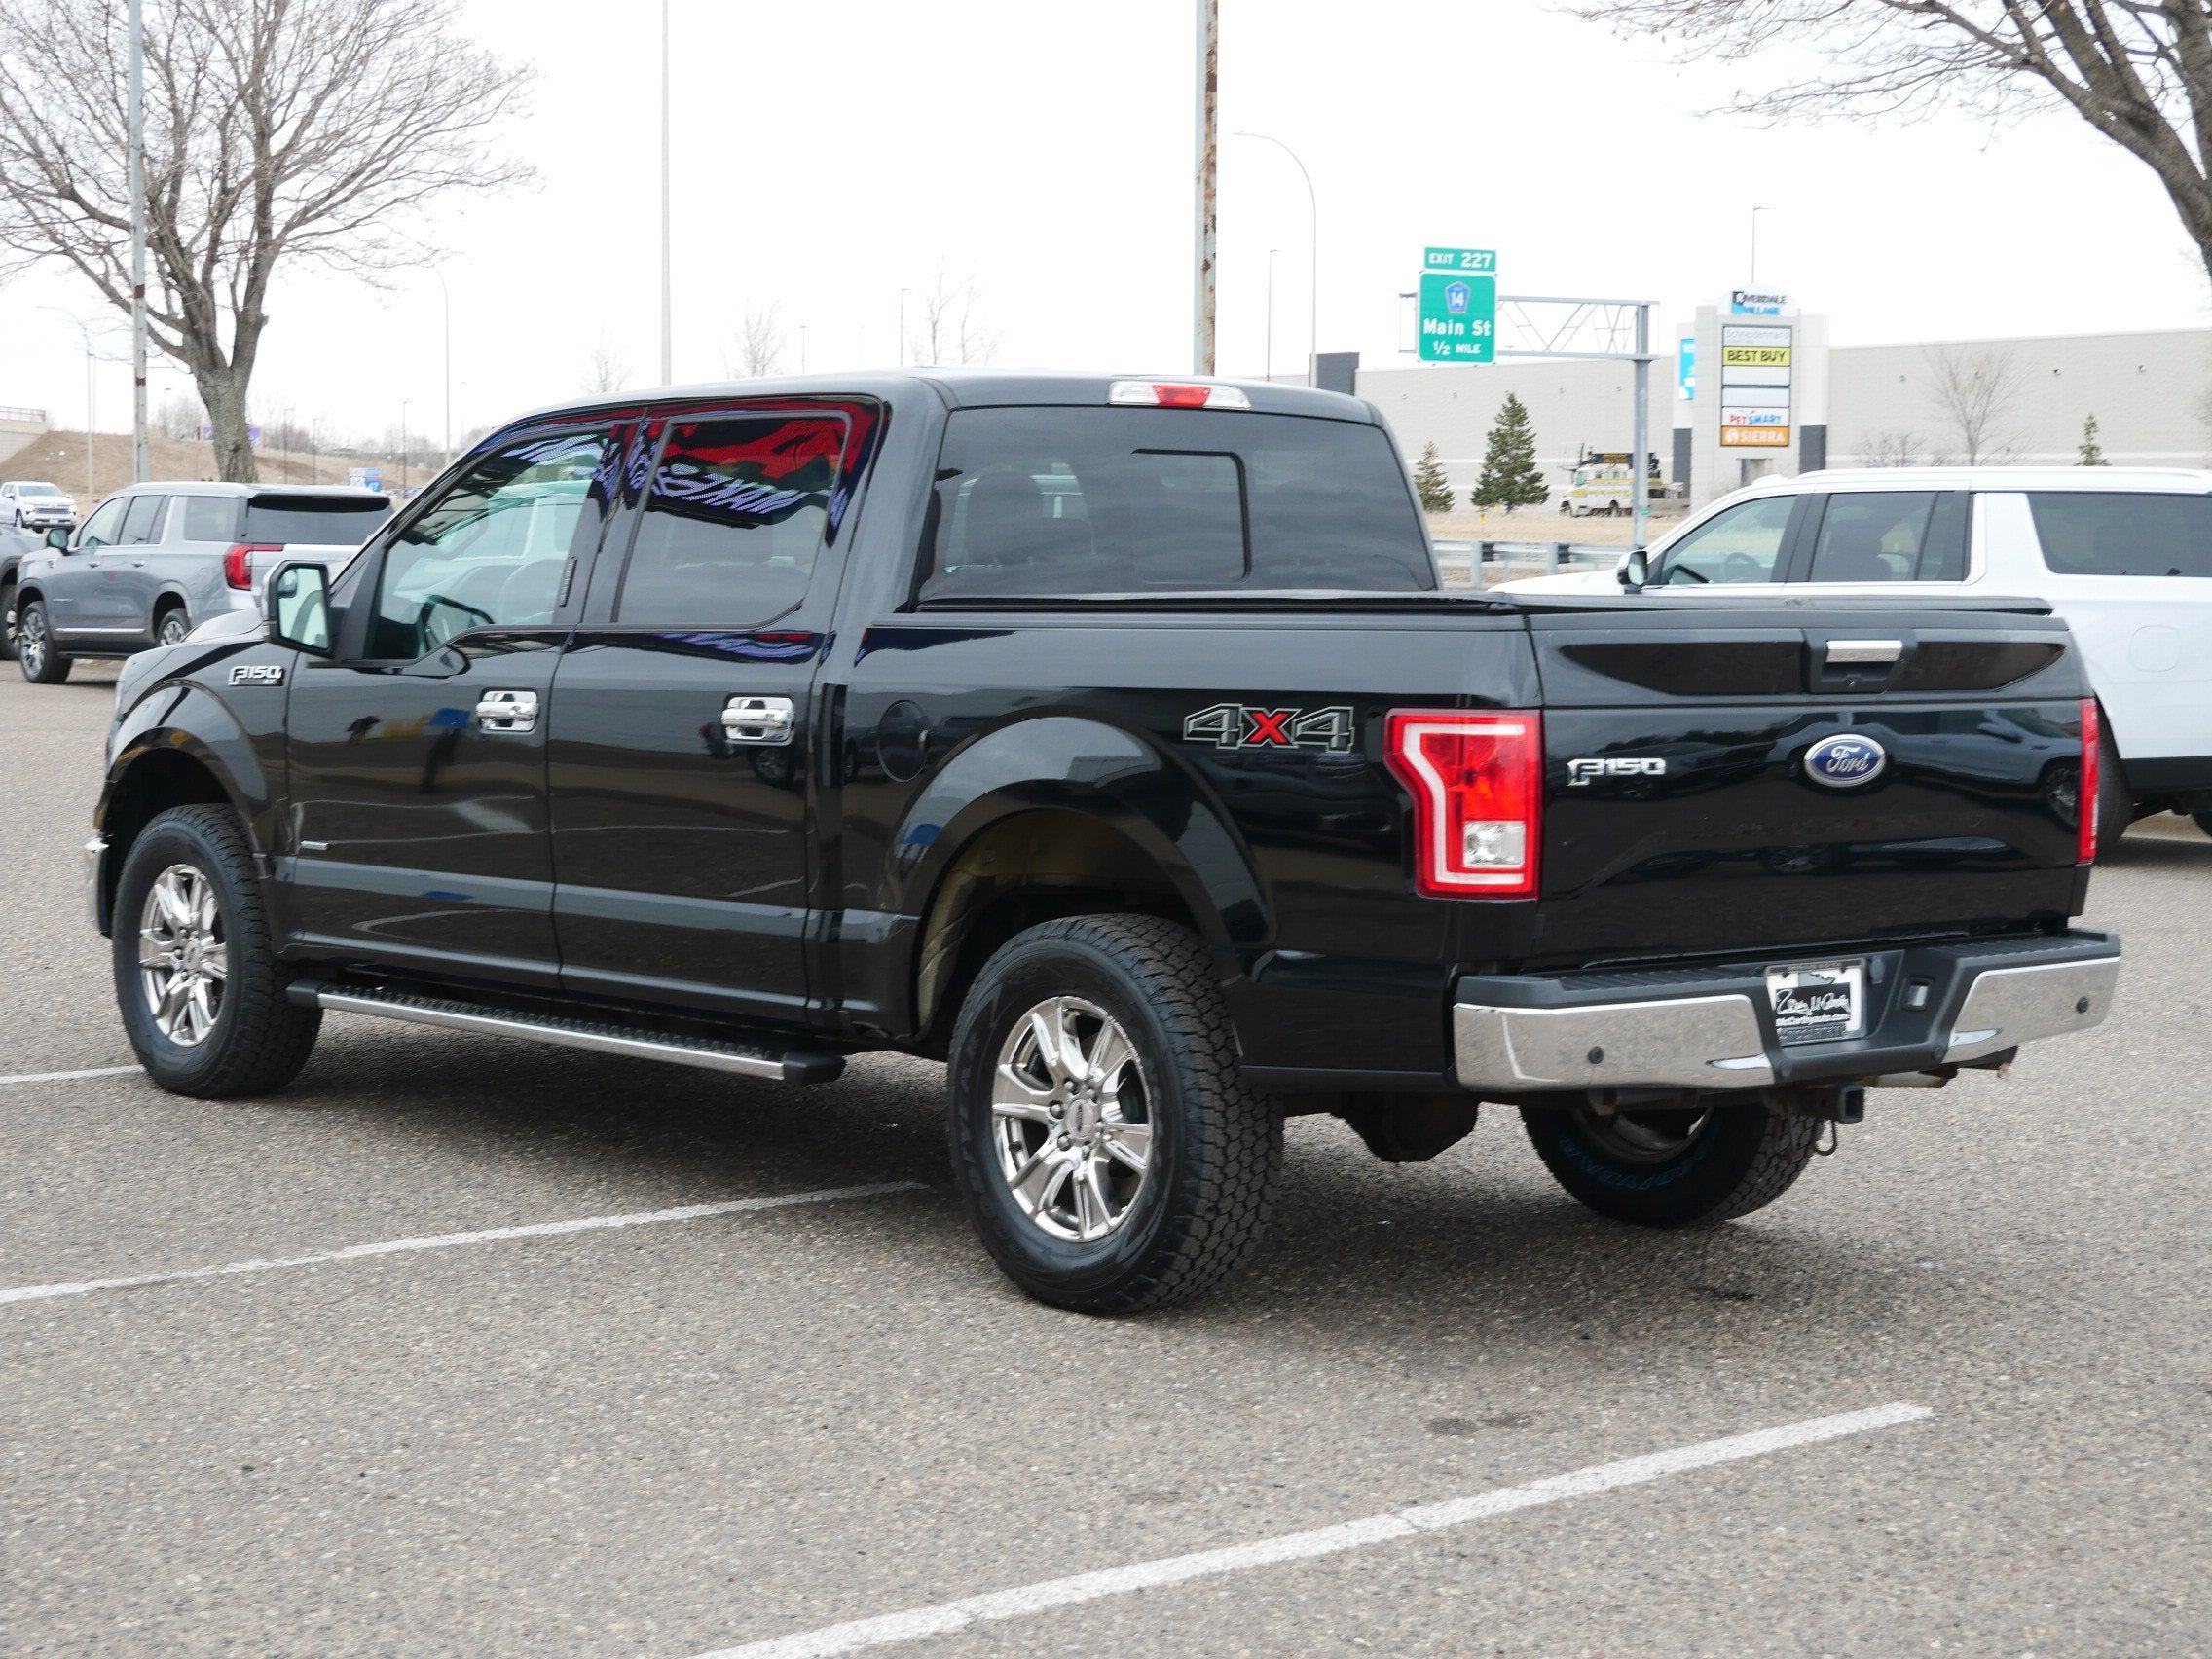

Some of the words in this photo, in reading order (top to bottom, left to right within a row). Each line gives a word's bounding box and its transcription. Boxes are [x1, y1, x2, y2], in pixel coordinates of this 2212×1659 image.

[1428, 253, 1454, 264] EXIT
[1461, 252, 1492, 268] 227
[1451, 291, 1464, 307] 14
[1423, 317, 1464, 335] Main
[1472, 319, 1492, 336] St
[1456, 344, 1481, 353] MILE
[1728, 350, 1757, 361] BEST
[1760, 350, 1786, 362] BUY
[1741, 430, 1784, 442] SIERRA
[1826, 745, 1870, 775] Ford
